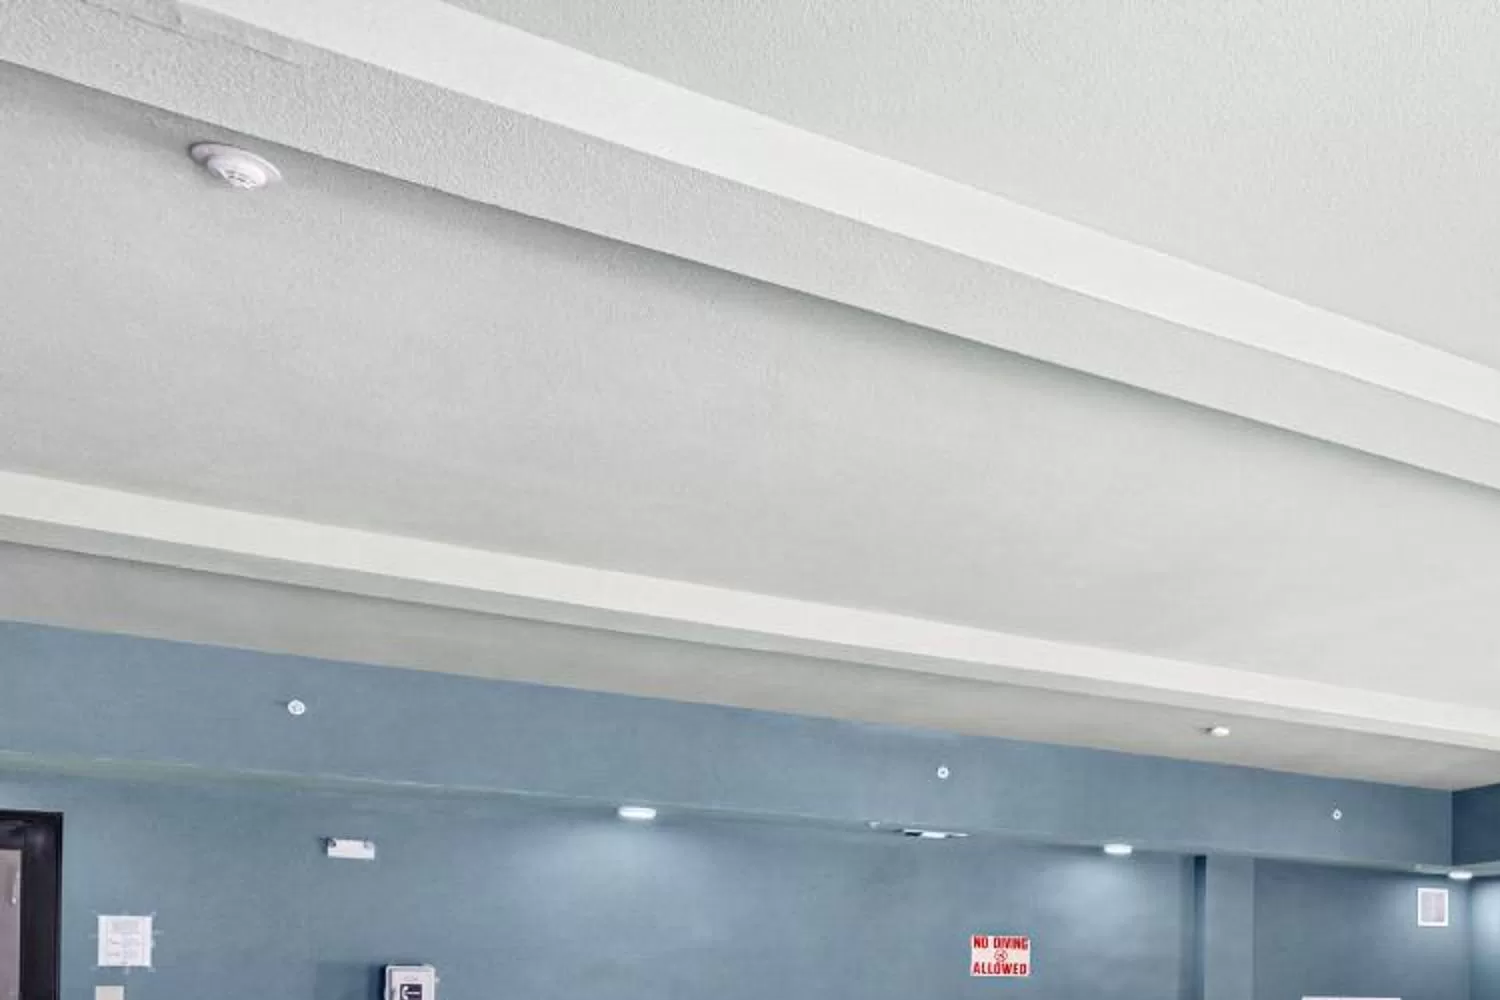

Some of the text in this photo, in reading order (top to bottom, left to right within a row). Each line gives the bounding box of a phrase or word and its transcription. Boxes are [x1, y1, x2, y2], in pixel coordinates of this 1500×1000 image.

[973, 937, 1028, 950] NO DIVING
[973, 962, 1027, 975] ALLOWED
